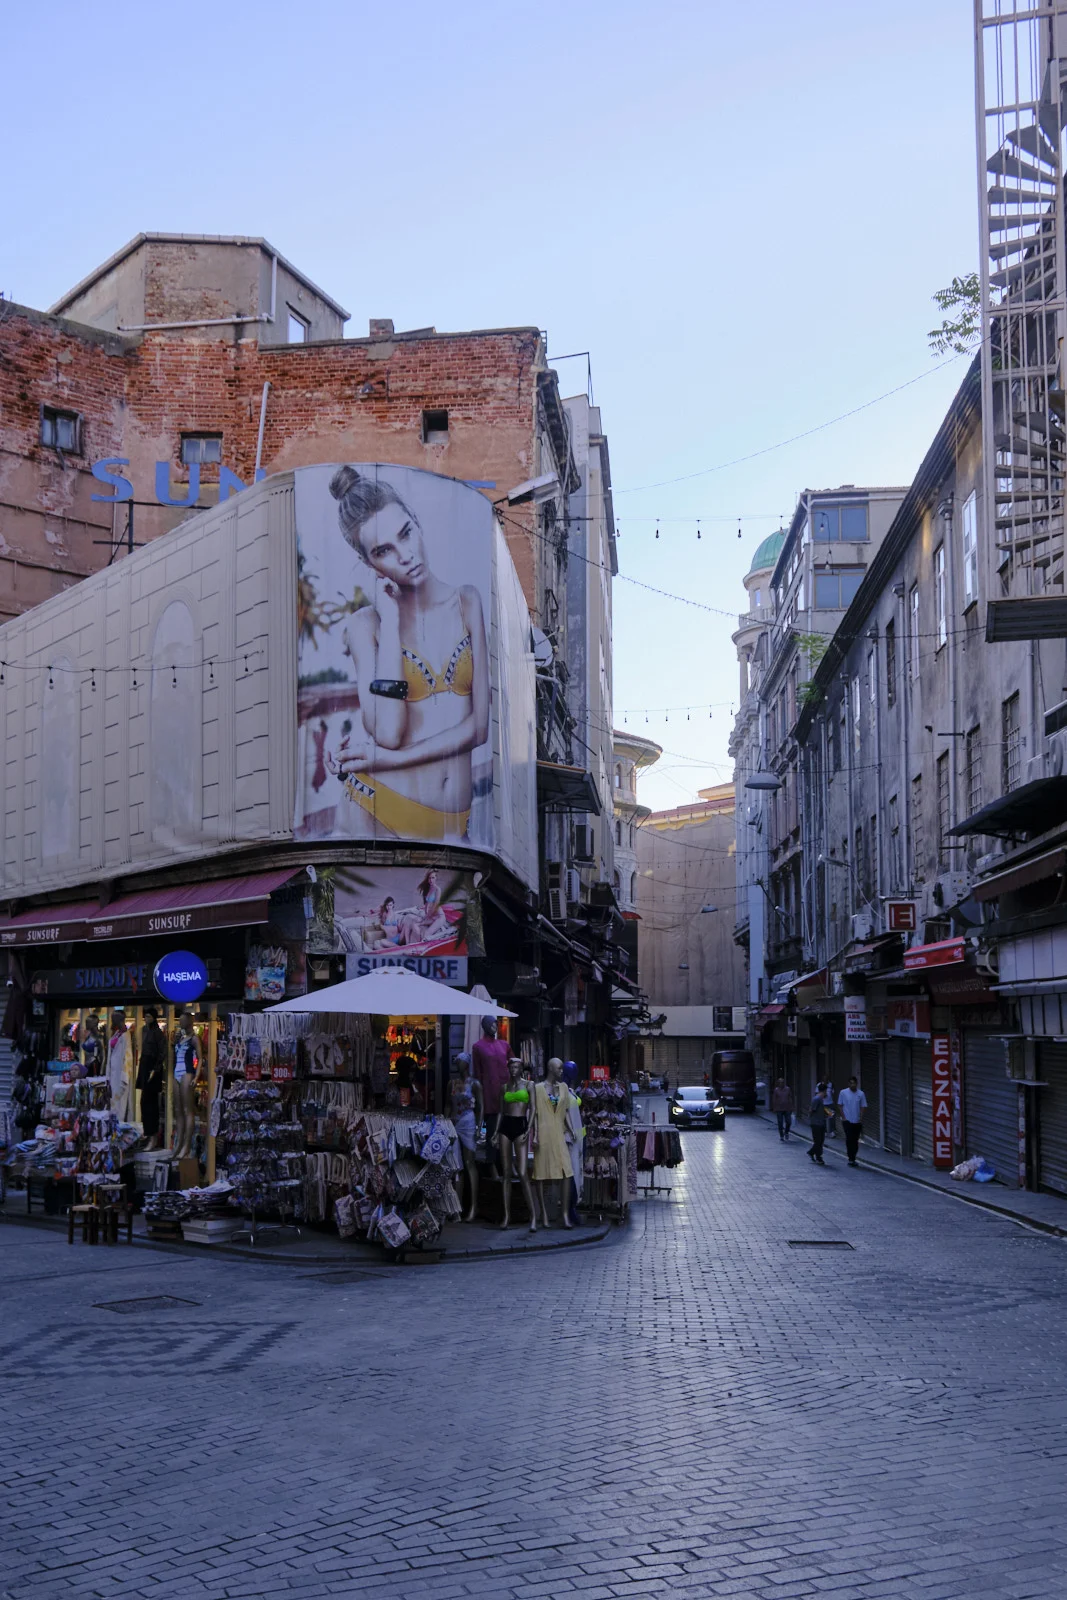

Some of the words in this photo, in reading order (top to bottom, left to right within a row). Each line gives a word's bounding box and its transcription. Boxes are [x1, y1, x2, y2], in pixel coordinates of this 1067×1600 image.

[148, 913, 192, 931] SUNSURF
[26, 927, 60, 941] SUNSURF
[75, 963, 148, 990] SUNSURF
[163, 971, 201, 983] HAŞEMA
[933, 1038, 951, 1158] ECZANE
